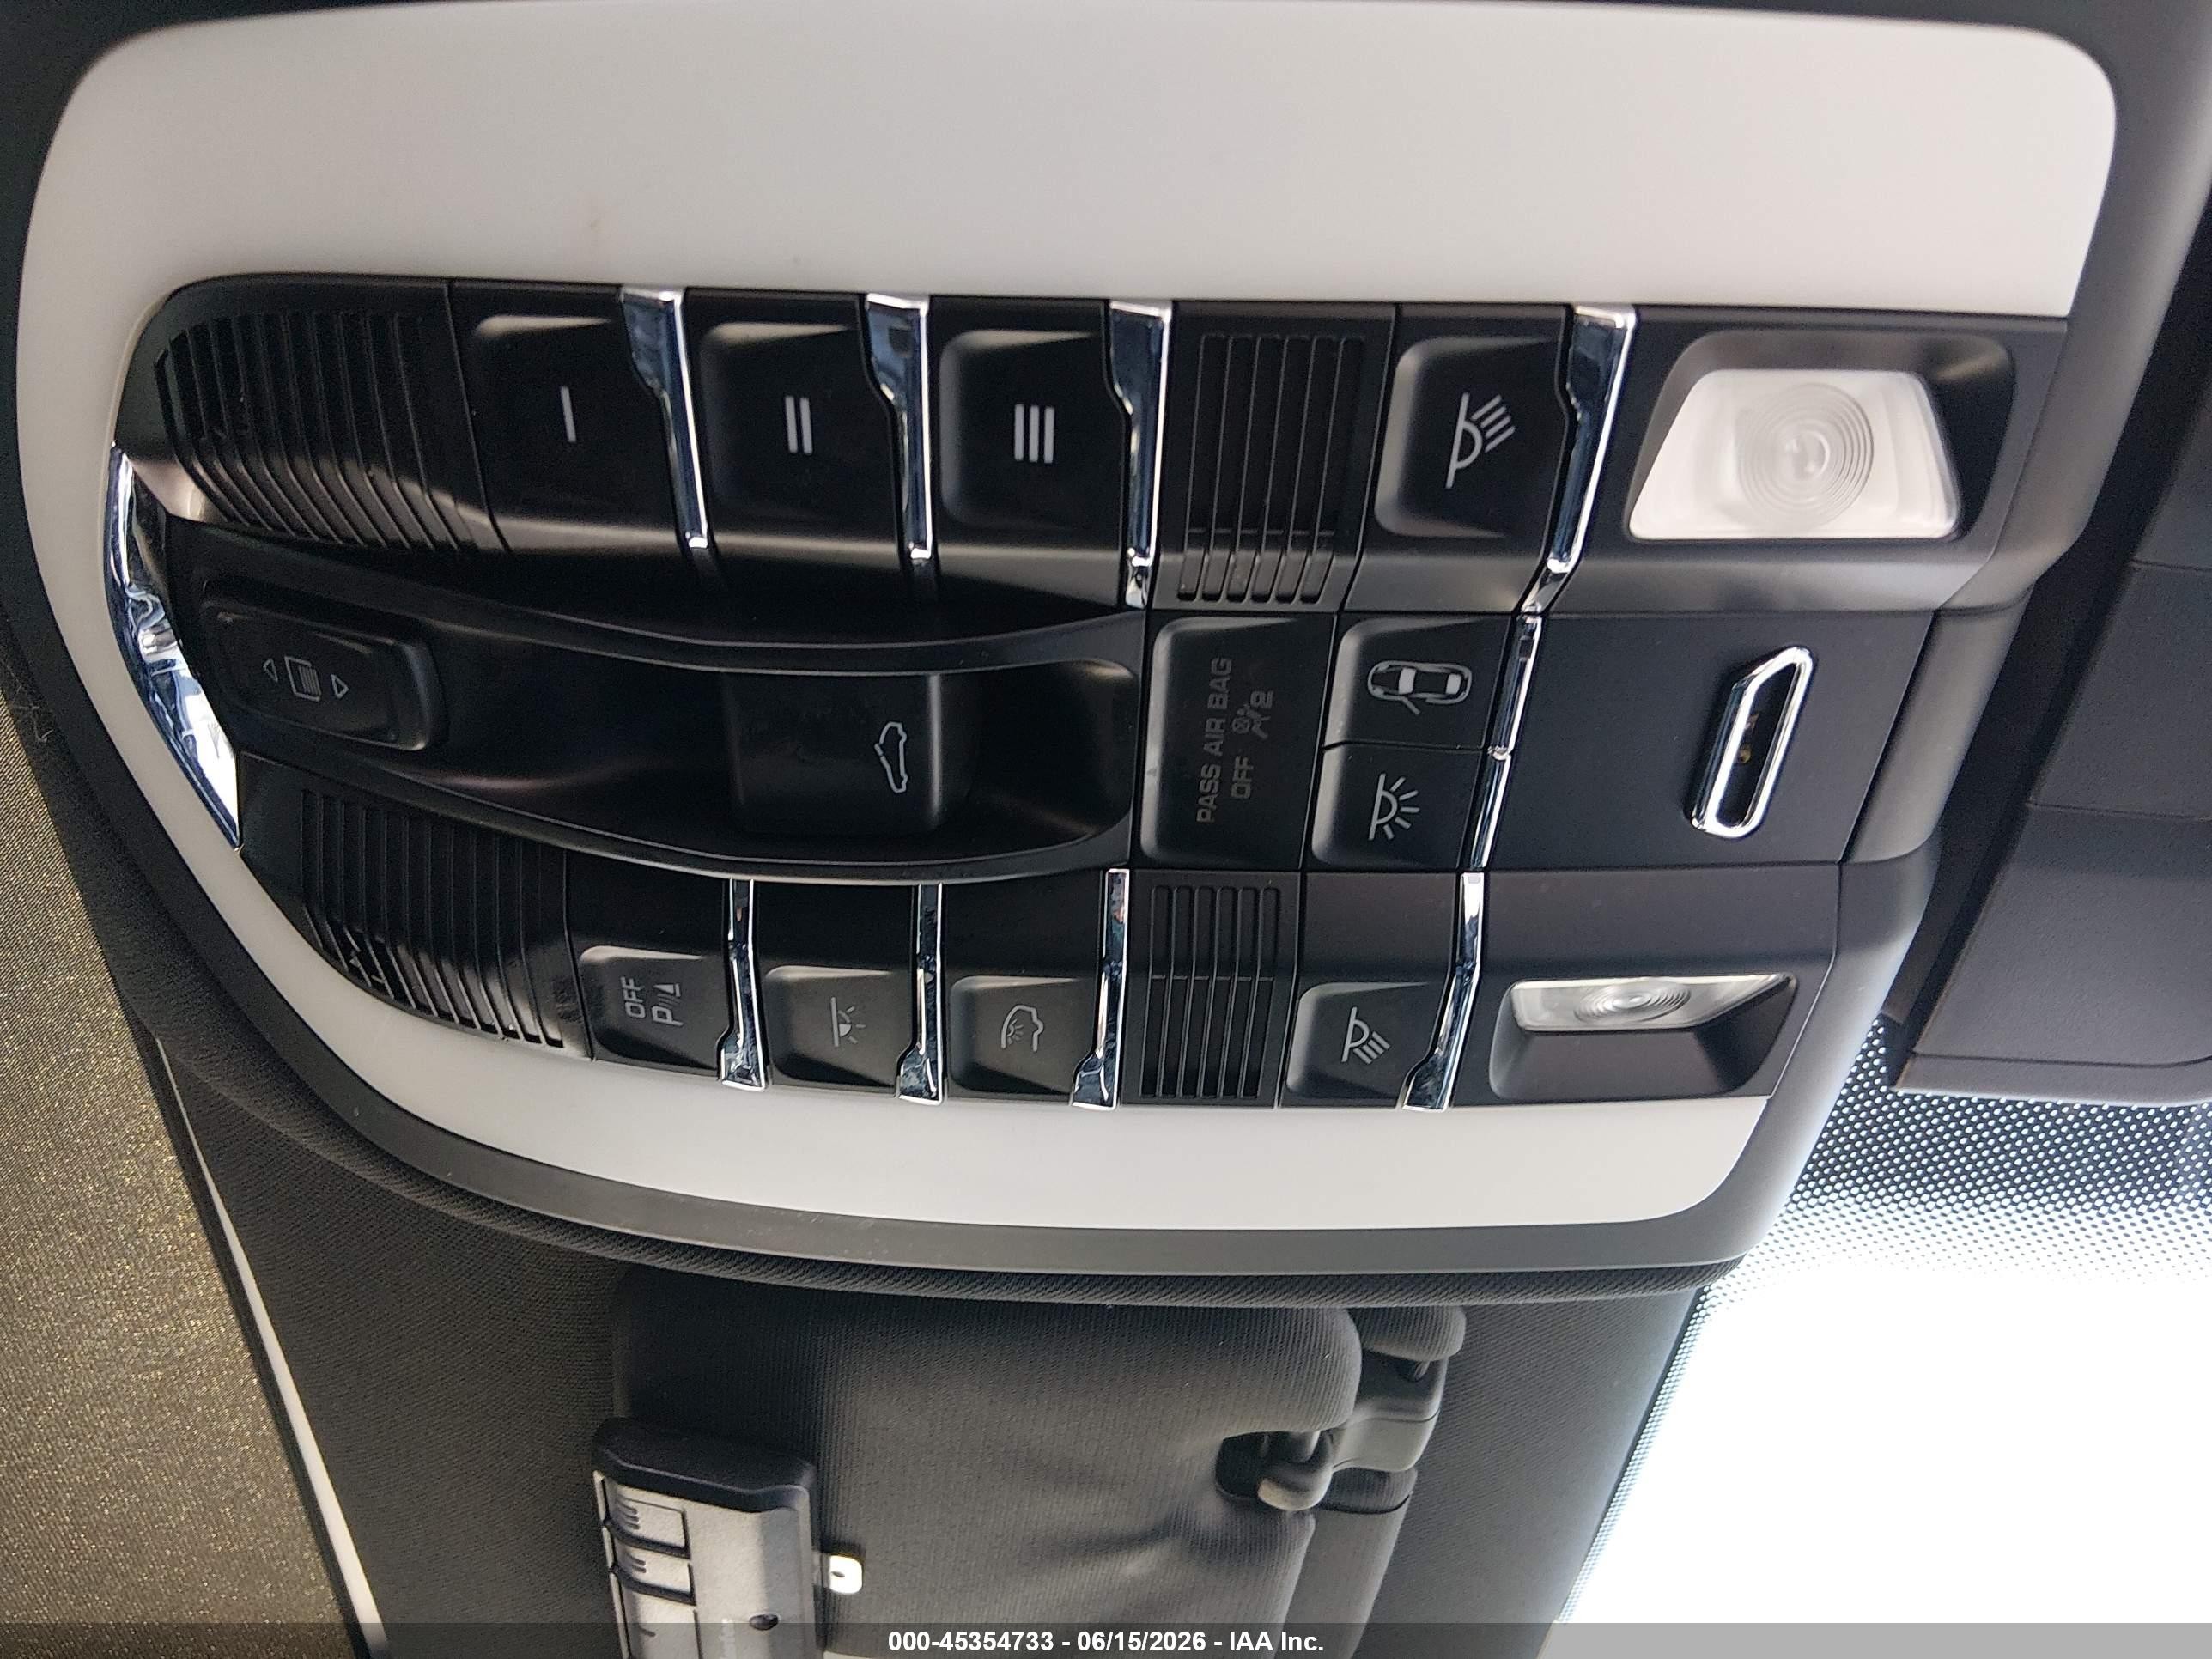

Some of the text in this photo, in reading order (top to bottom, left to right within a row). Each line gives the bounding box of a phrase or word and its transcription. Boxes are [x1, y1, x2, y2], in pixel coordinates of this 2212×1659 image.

[1196, 657, 1231, 823] PASS AIR BAG
[1231, 755, 1255, 799] OFF
[620, 976, 646, 1018] OFF
